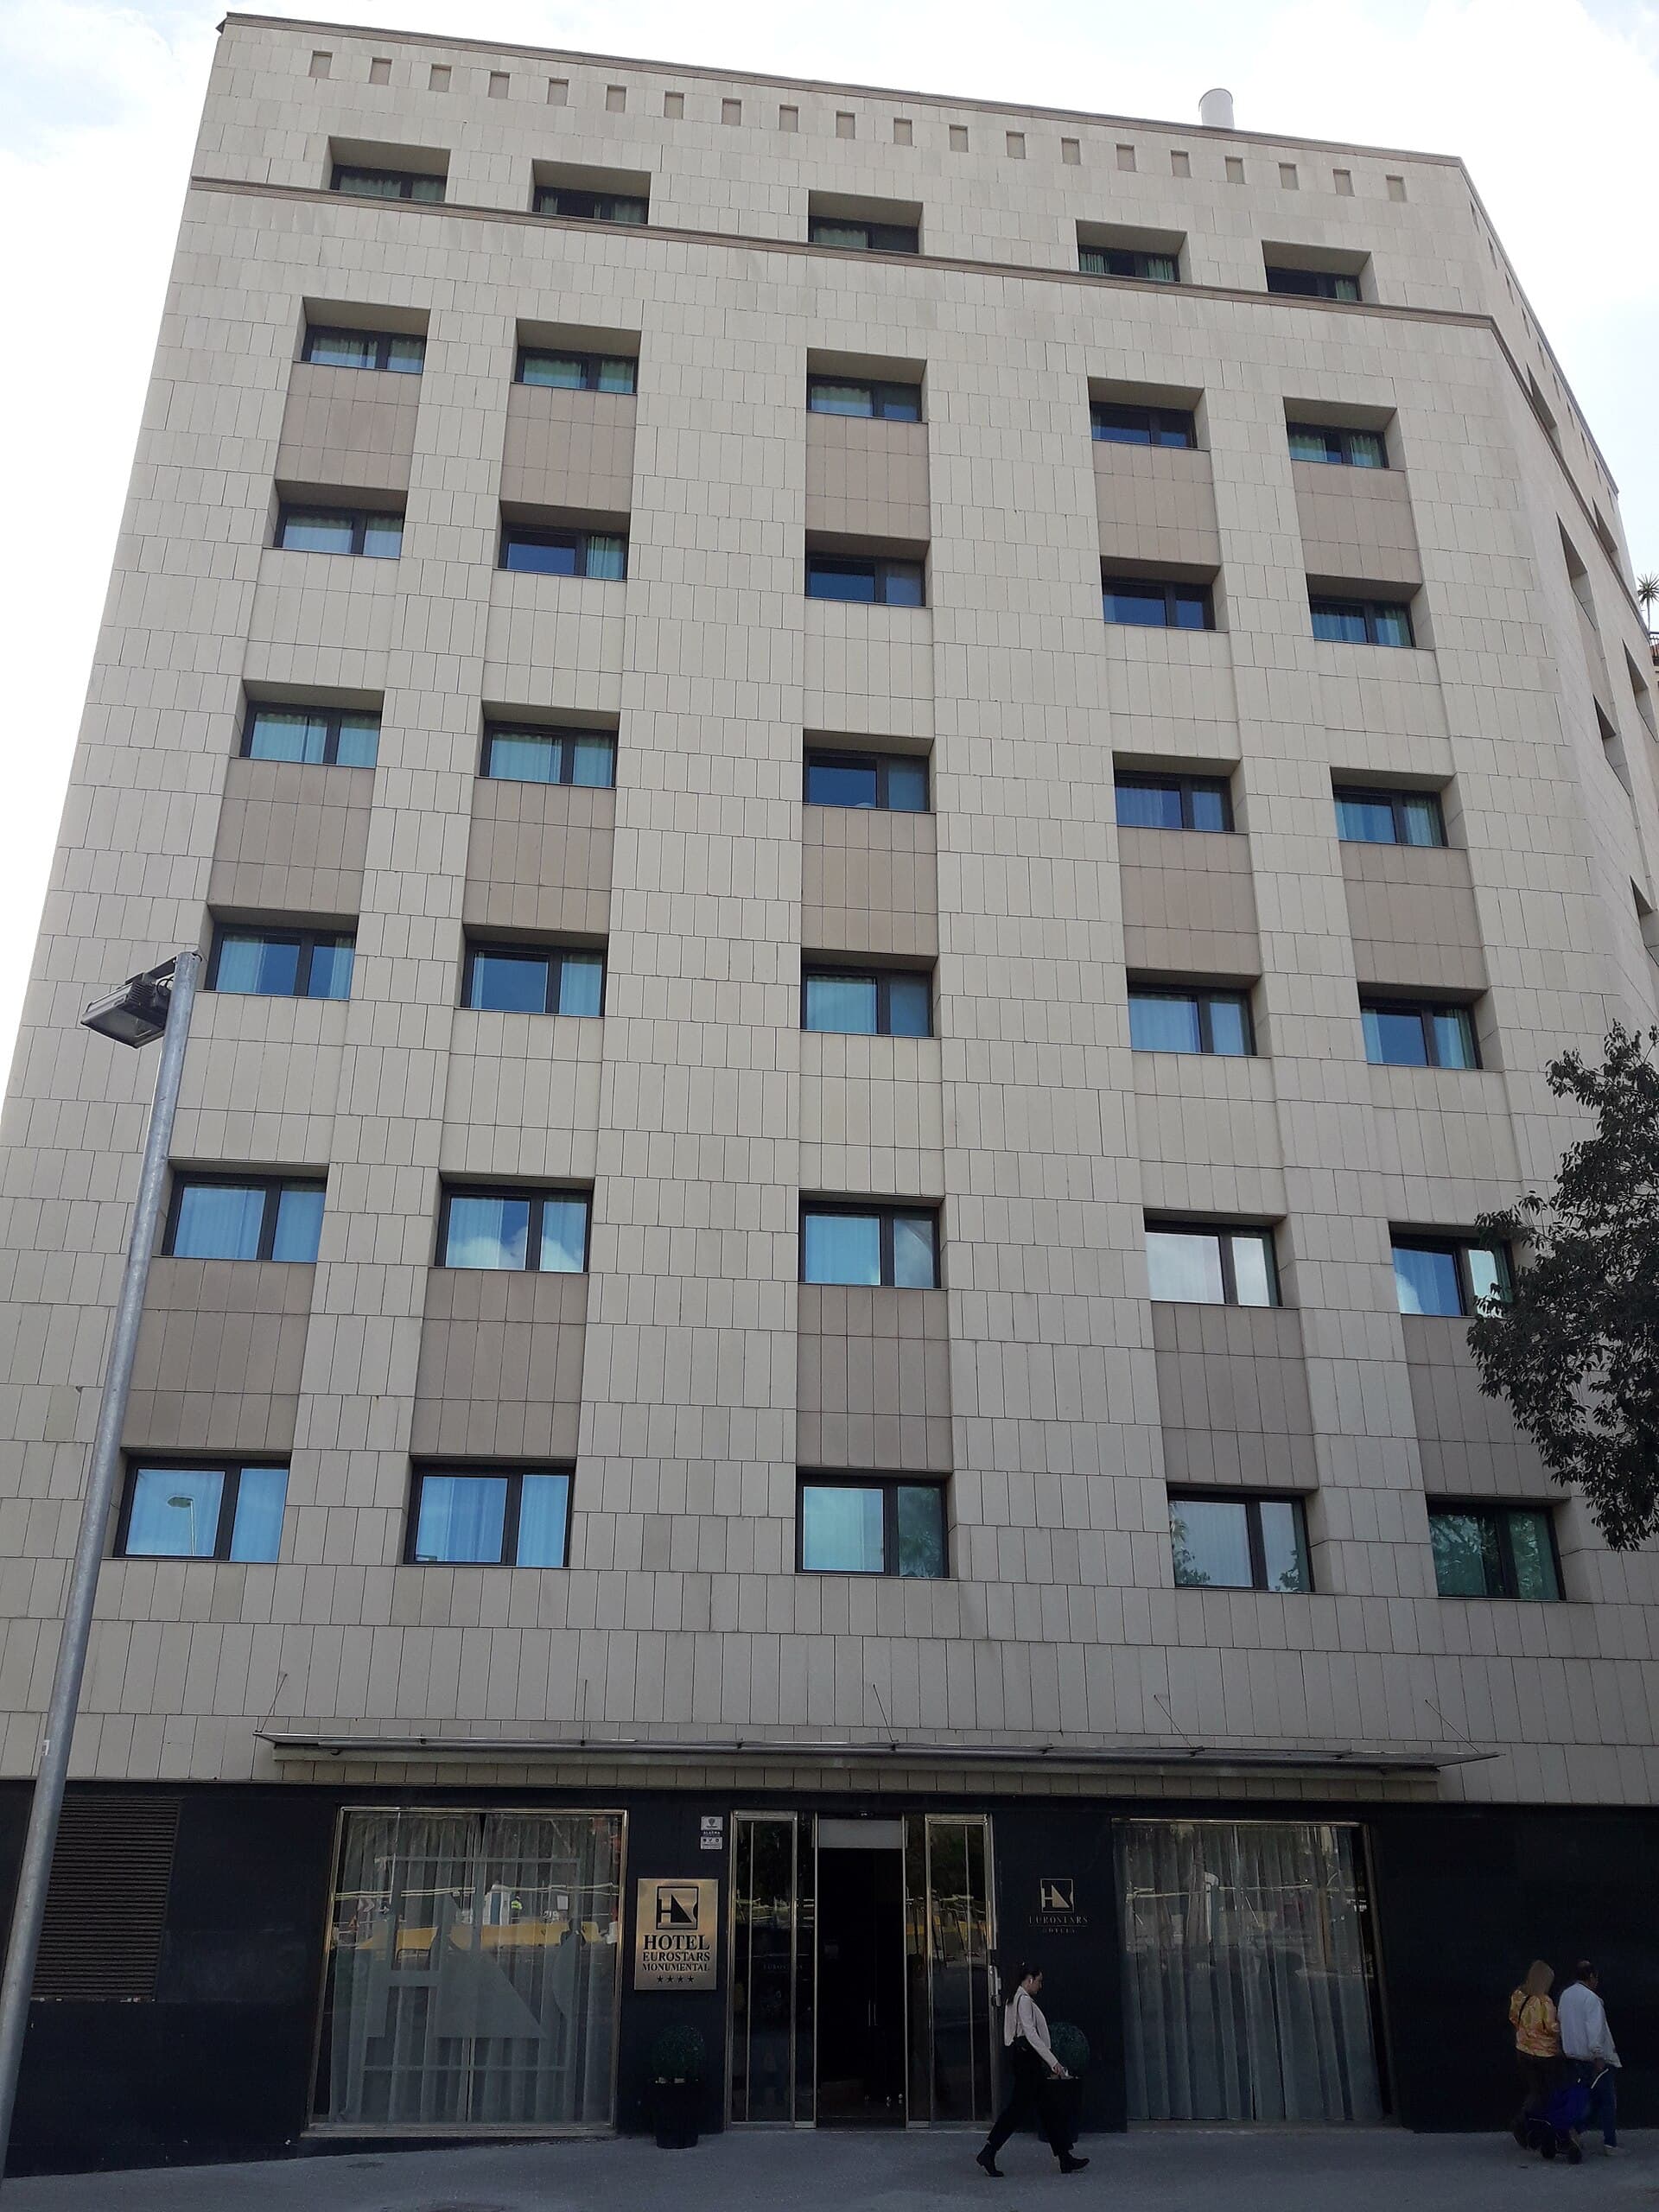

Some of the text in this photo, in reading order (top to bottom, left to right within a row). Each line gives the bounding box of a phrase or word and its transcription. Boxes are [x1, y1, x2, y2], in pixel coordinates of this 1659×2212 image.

[643, 1935, 710, 1951] HOTEL
[642, 1951, 710, 1962] EUROSTARS
[642, 1962, 710, 1972] MONUMENTAL
